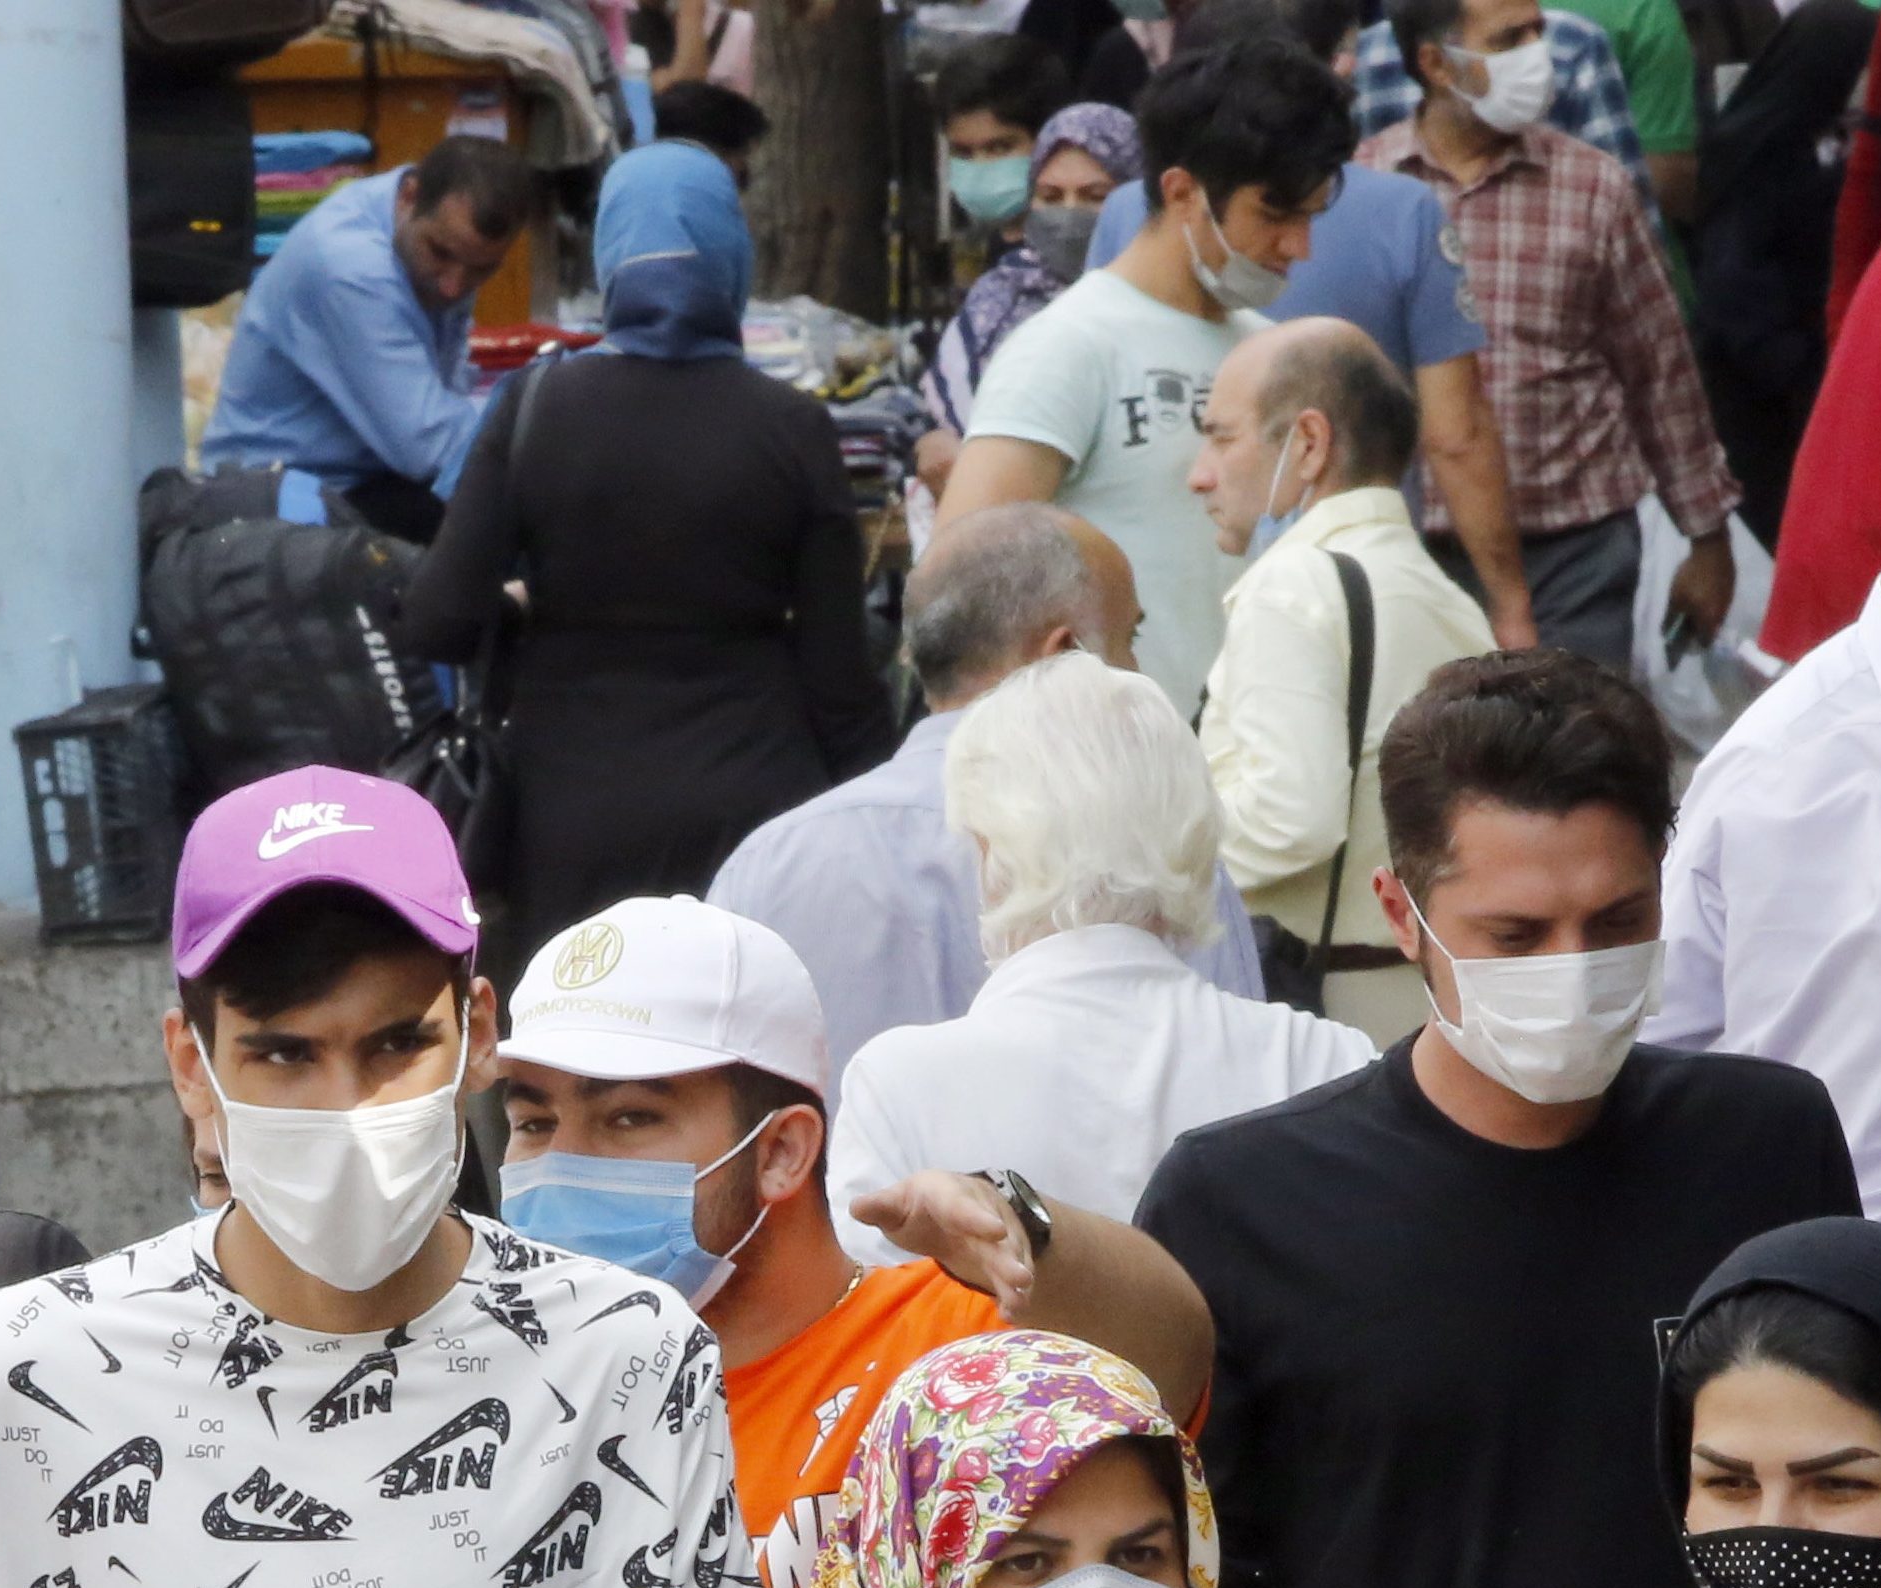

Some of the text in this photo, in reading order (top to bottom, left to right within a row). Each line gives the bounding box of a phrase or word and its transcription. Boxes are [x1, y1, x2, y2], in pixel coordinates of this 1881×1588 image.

[273, 802, 346, 834] NIKE
[7, 1296, 47, 1337] JUST
[490, 1283, 548, 1344] NIKE
[446, 1357, 490, 1373] JUST
[649, 1331, 680, 1382] JUST
[611, 1356, 646, 1412] DO IT
[309, 1379, 392, 1433] NIKE
[1, 1427, 40, 1442] JUST
[199, 1419, 224, 1433] DO
[25, 1449, 48, 1464] DO
[185, 1444, 225, 1459] JUST
[540, 1444, 571, 1468] JUST
[41, 1468, 53, 1483] IT
[380, 1443, 497, 1500] NIKE
[57, 1479, 152, 1537] NIKE
[232, 1466, 352, 1537] NIKE
[428, 1510, 470, 1530] JUST
[453, 1530, 481, 1548] DO
[473, 1547, 487, 1563] IT
[327, 1568, 351, 1586] DO
